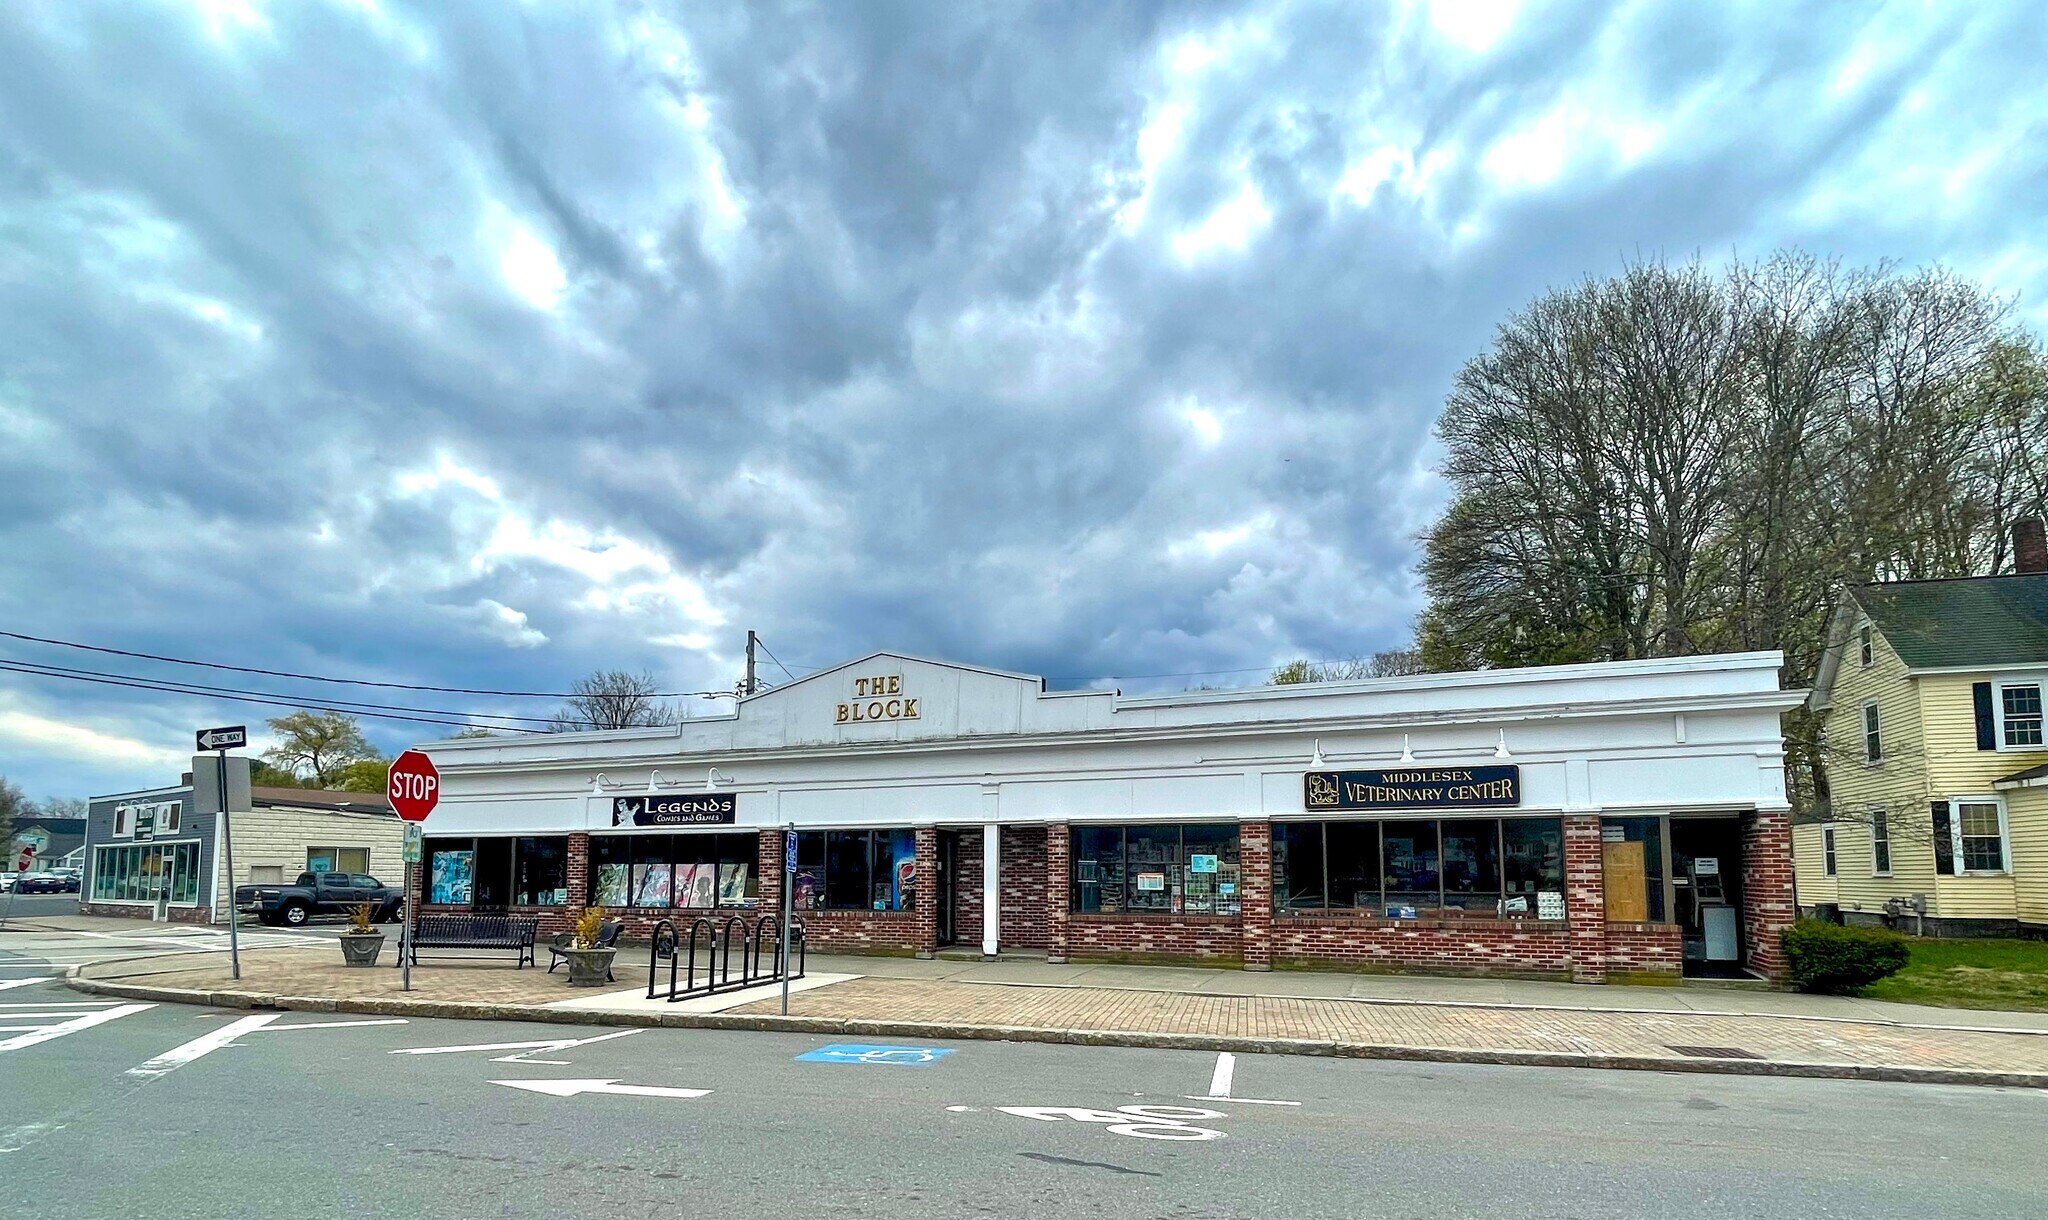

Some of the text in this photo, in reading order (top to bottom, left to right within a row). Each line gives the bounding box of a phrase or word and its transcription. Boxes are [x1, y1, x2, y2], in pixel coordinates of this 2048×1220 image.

[856, 676, 900, 696] THE
[837, 698, 917, 722] BLOCK
[211, 733, 241, 743] ONE WAY
[391, 771, 437, 801] STOP
[1382, 771, 1473, 784] MIDDLESEX
[1345, 779, 1514, 802] VETERINARY CENTER
